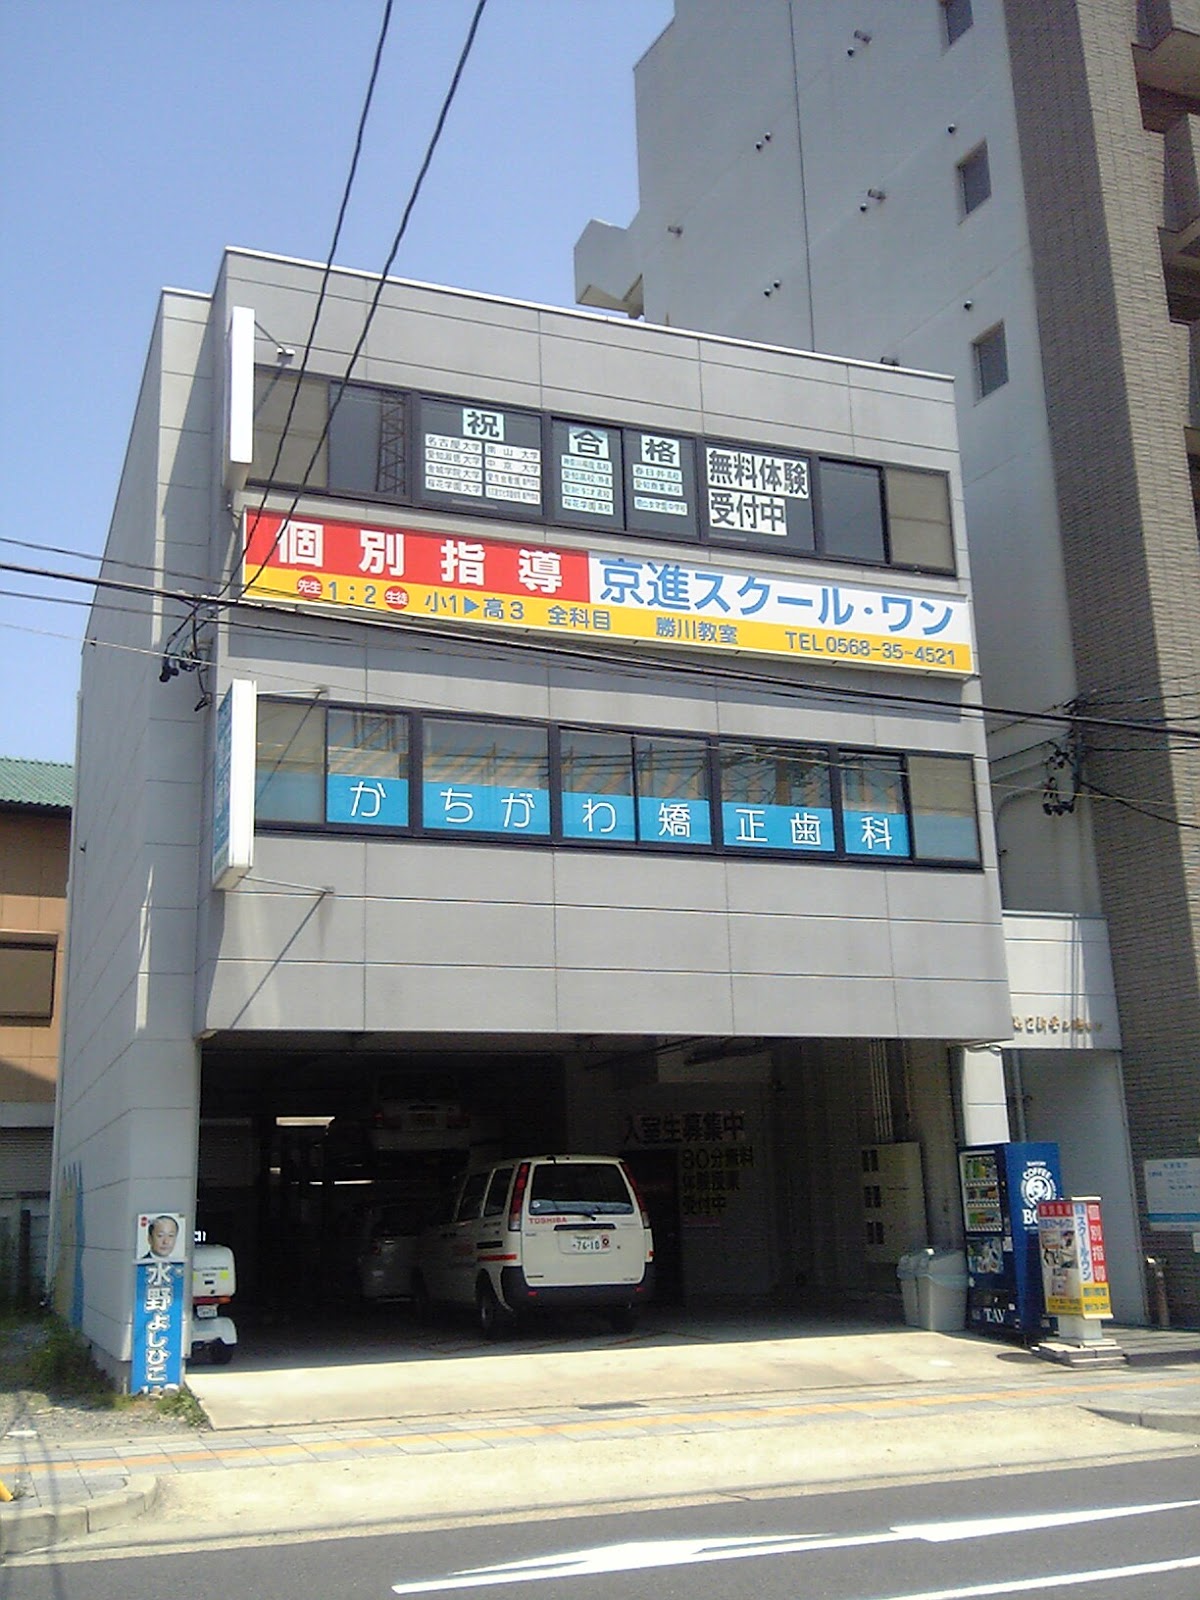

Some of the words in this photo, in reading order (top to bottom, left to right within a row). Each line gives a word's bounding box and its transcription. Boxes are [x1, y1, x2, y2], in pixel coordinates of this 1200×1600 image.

[467, 411, 499, 438] 祝
[573, 430, 603, 455] 合
[645, 438, 676, 464] 格
[707, 448, 808, 497] 無料体験
[709, 491, 787, 533] 受付中
[276, 519, 562, 594] 個別指導
[298, 580, 322, 595] 先生
[384, 591, 408, 606] 生徒
[548, 605, 611, 631] 全科目
[656, 616, 739, 645] 勝川教室
[599, 558, 954, 636] 京進スクール・ワン
[1023, 1167, 1053, 1180] COFFEE
[528, 1216, 568, 1225] TOSHIBA
[145, 1262, 172, 1383] 水野よしひこ
